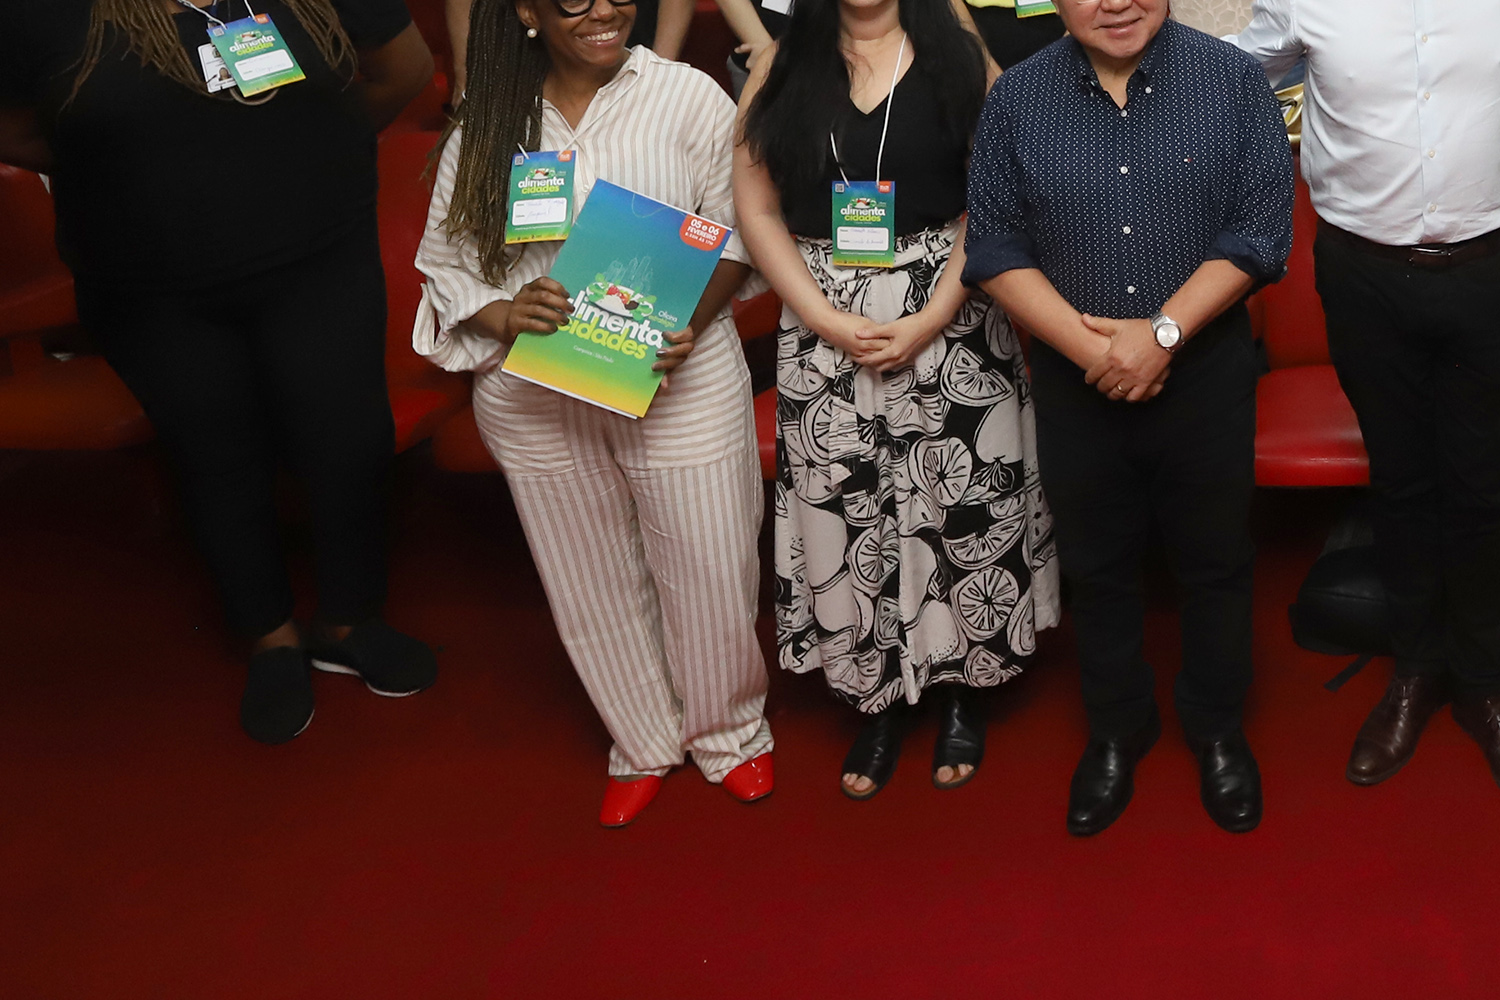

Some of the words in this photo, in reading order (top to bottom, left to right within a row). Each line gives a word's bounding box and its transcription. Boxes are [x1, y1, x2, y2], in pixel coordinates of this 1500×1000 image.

[229, 34, 276, 53] alimenta
[518, 176, 565, 188] alimenta
[521, 184, 560, 194] cidades
[840, 204, 886, 216] alimenta
[844, 214, 882, 222] cidades
[687, 225, 717, 242] FEVEREIRO
[690, 218, 703, 229] 05
[708, 226, 720, 236] 06
[565, 290, 665, 349] limenta
